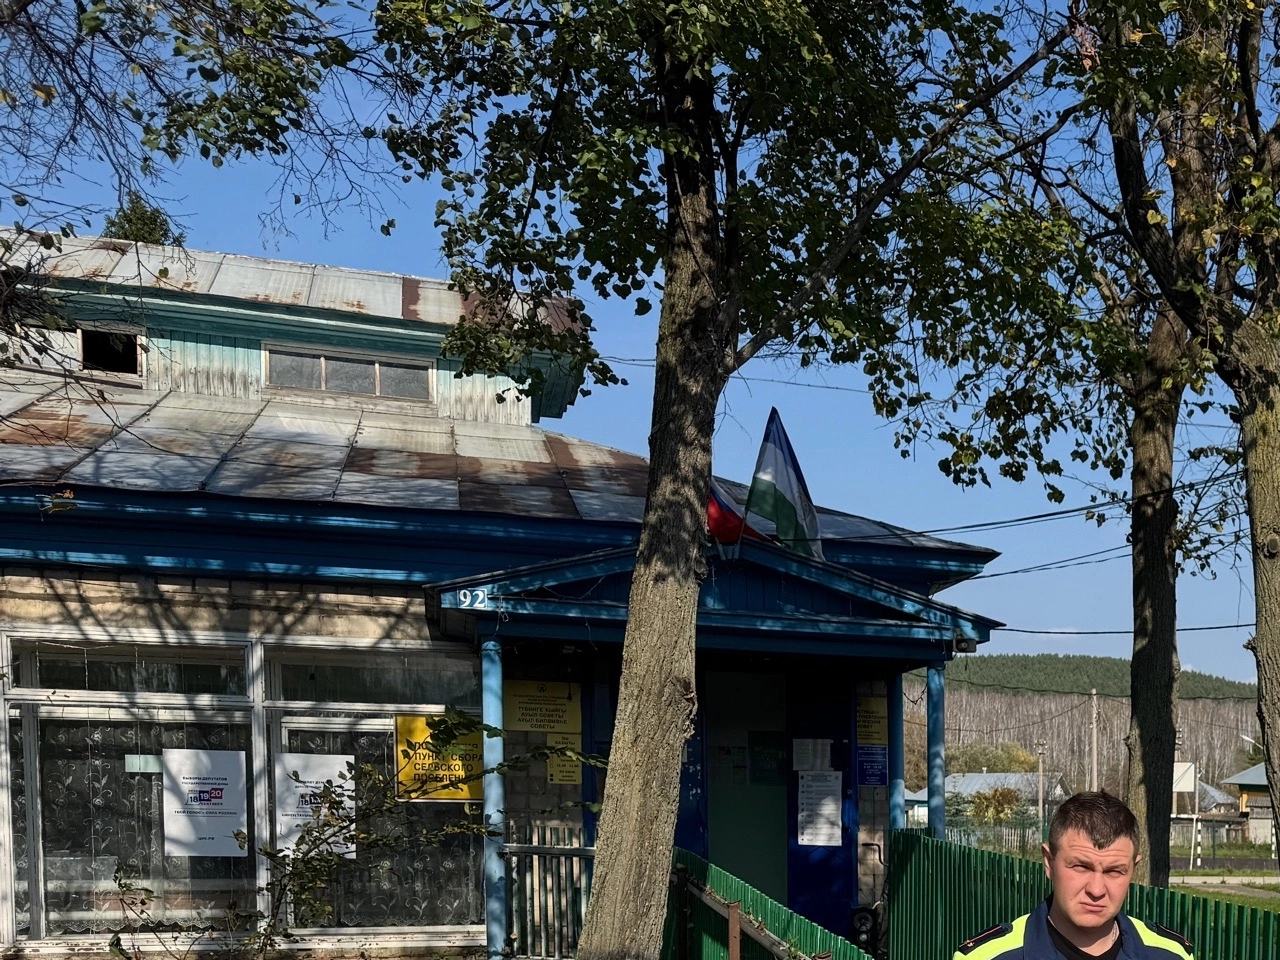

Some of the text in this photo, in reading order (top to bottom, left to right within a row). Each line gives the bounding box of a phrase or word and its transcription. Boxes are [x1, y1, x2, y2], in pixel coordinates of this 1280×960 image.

[459, 589, 485, 608] 92
[414, 752, 483, 761] ПУНКТ СБОРА
[413, 762, 474, 772] СЕЛЬСКОГО
[413, 773, 473, 782] ПОСЕЛЕНИ
[200, 792, 209, 800] 19
